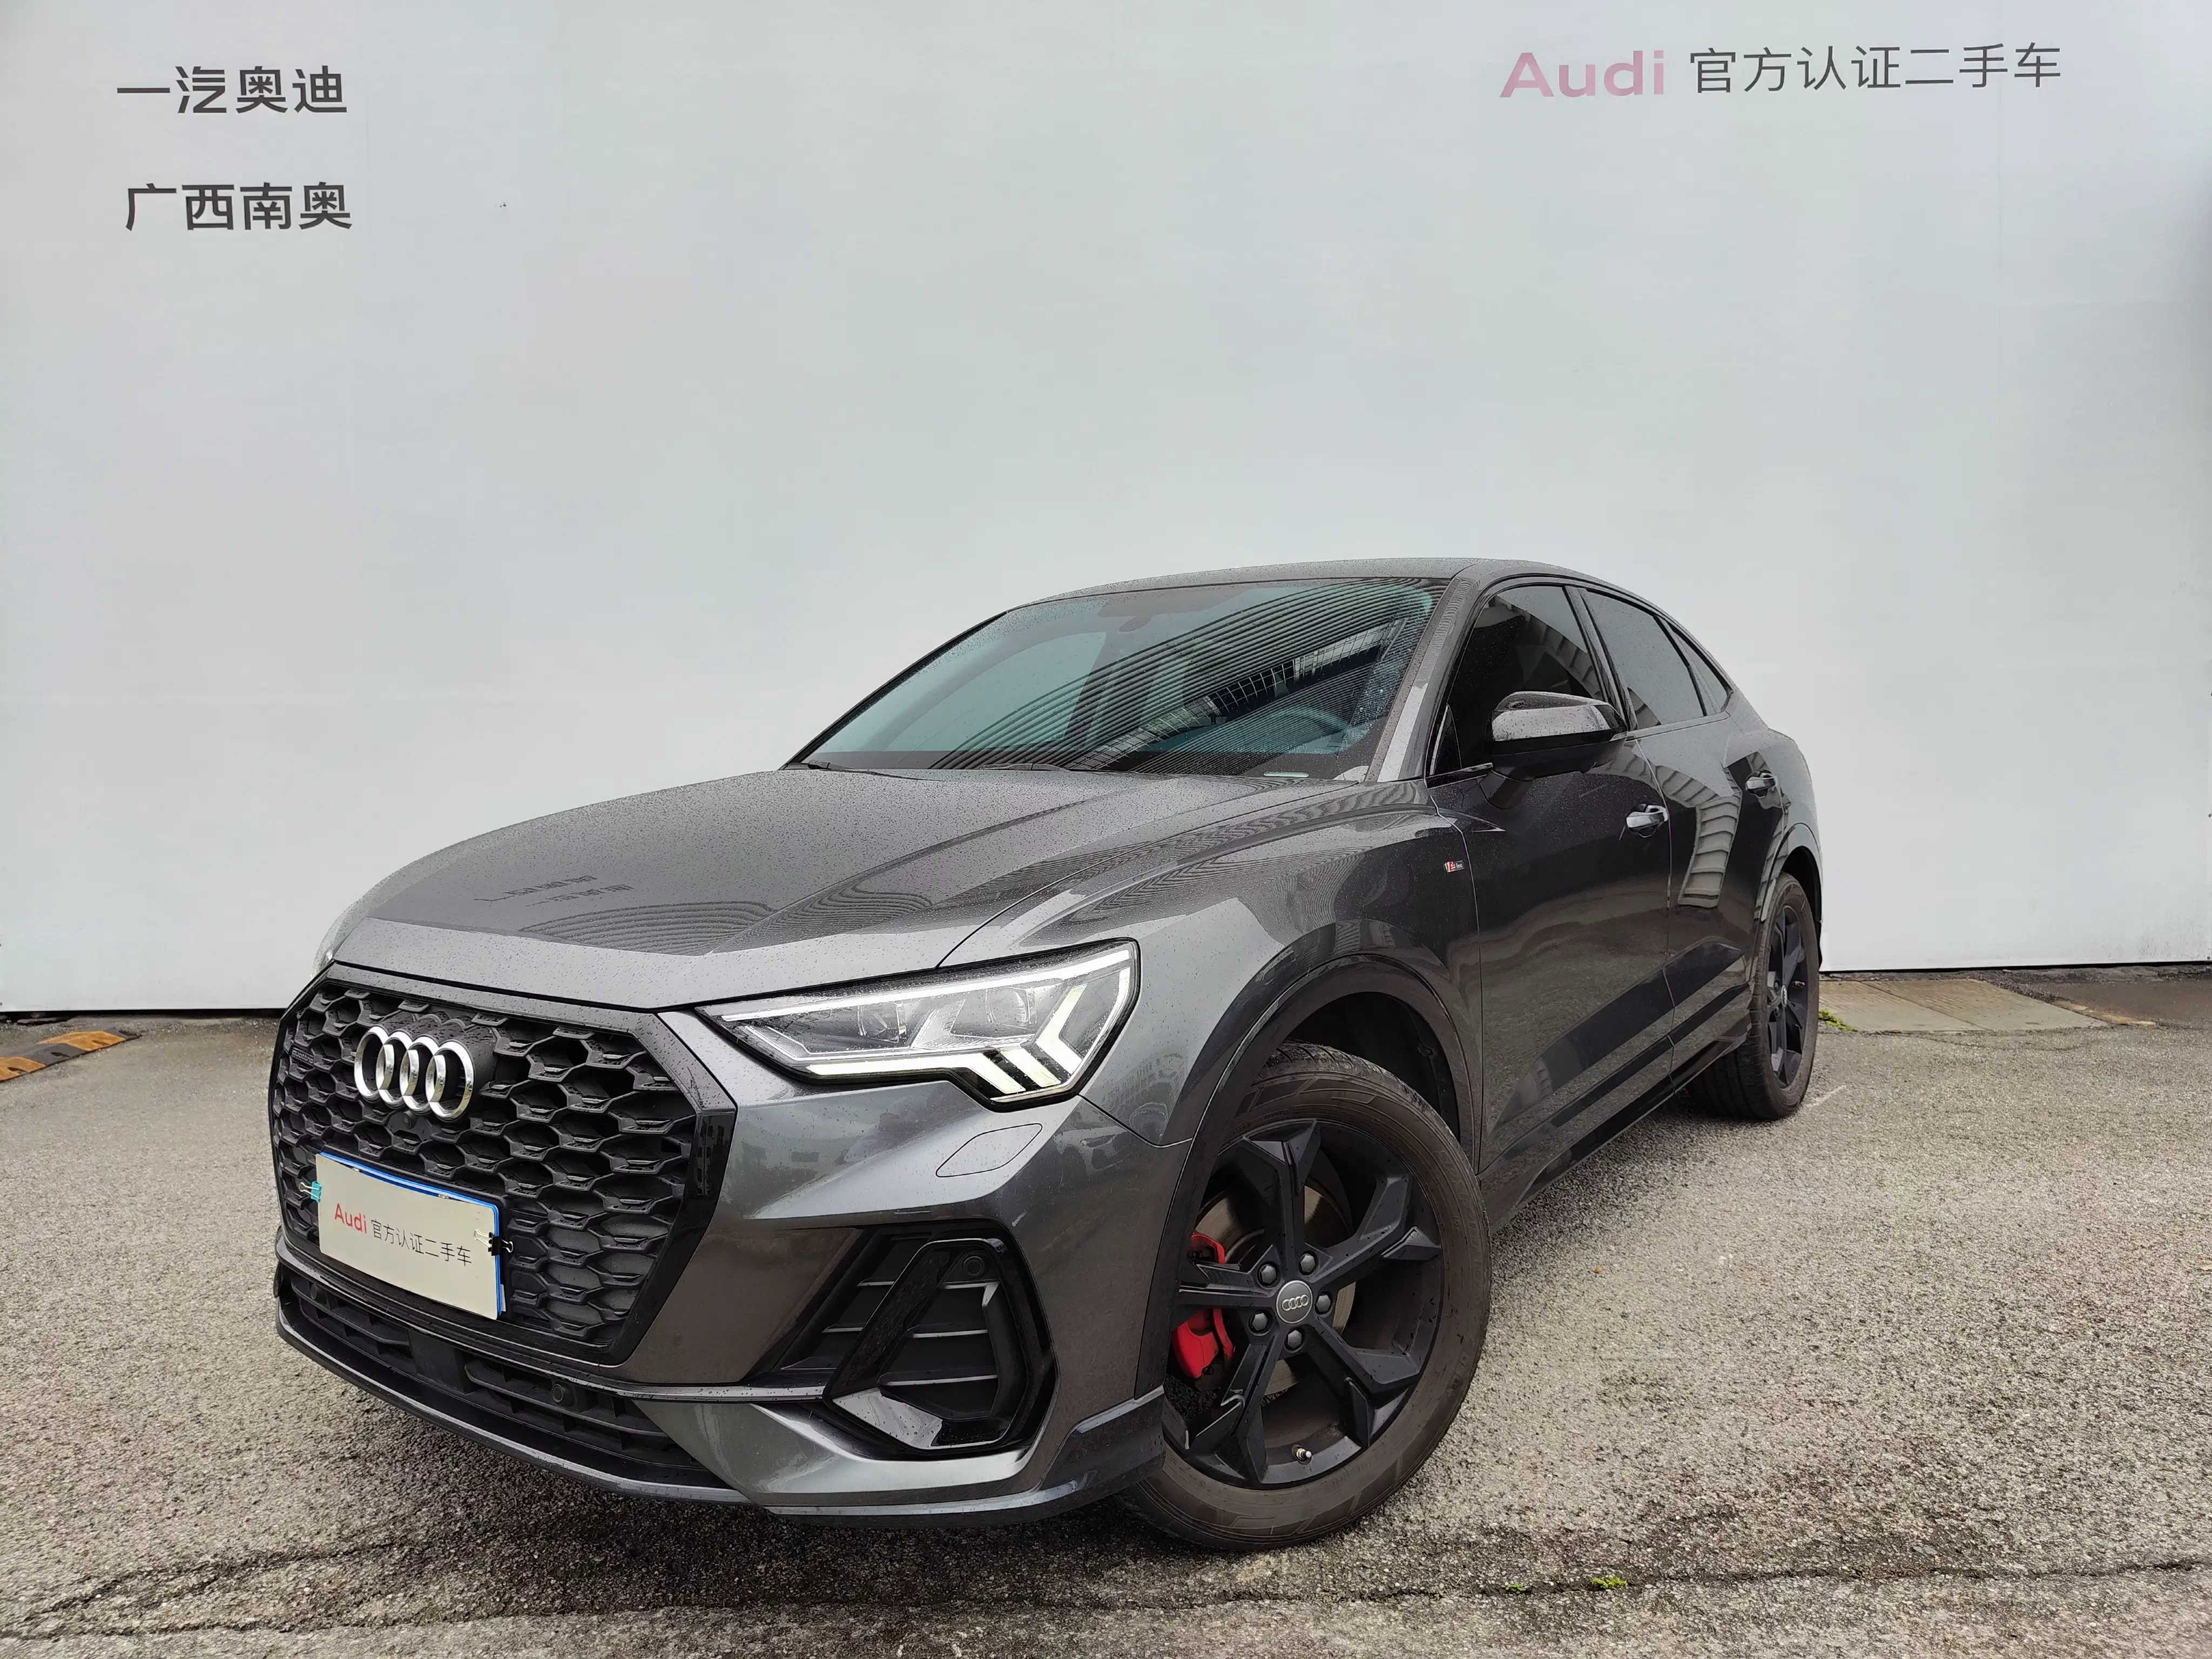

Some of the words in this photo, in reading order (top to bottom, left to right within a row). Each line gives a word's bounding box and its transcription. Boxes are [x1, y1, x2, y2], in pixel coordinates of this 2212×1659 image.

[116, 64, 347, 114] 一汽奥迪
[1500, 50, 1664, 98] Audi
[1690, 42, 2061, 93] 官方认证二手车
[125, 181, 353, 232] 广西南奥
[292, 1049, 314, 1064] quattro
[334, 1203, 367, 1234] Audi
[371, 1218, 472, 1267] 官方认证二手车
